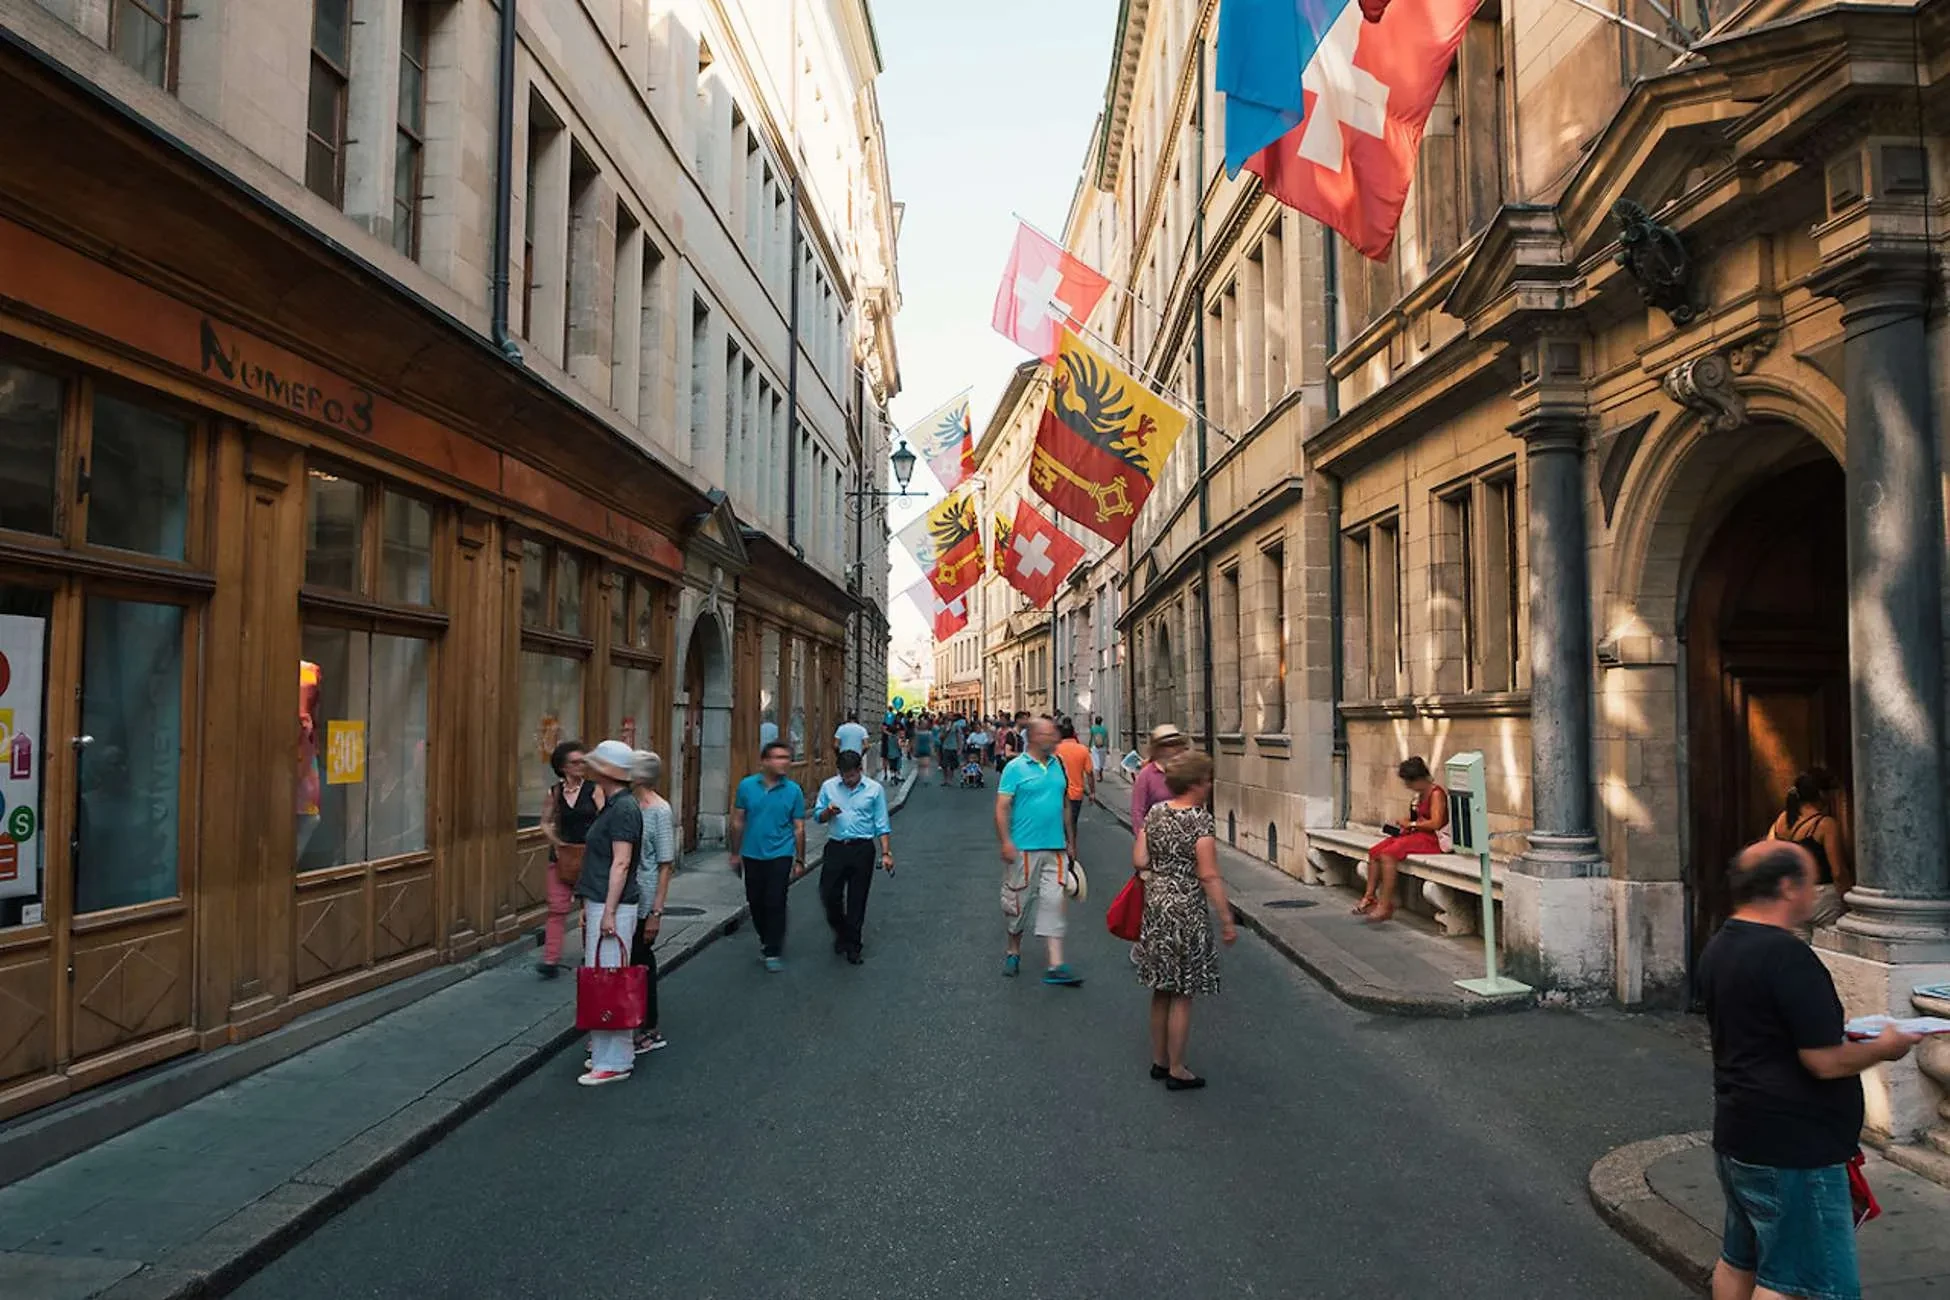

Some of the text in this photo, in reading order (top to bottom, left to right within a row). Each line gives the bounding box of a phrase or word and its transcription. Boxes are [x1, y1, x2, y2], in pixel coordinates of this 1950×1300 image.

[346, 385, 373, 434] 3
[15, 744, 28, 775] L
[16, 813, 29, 835] S
